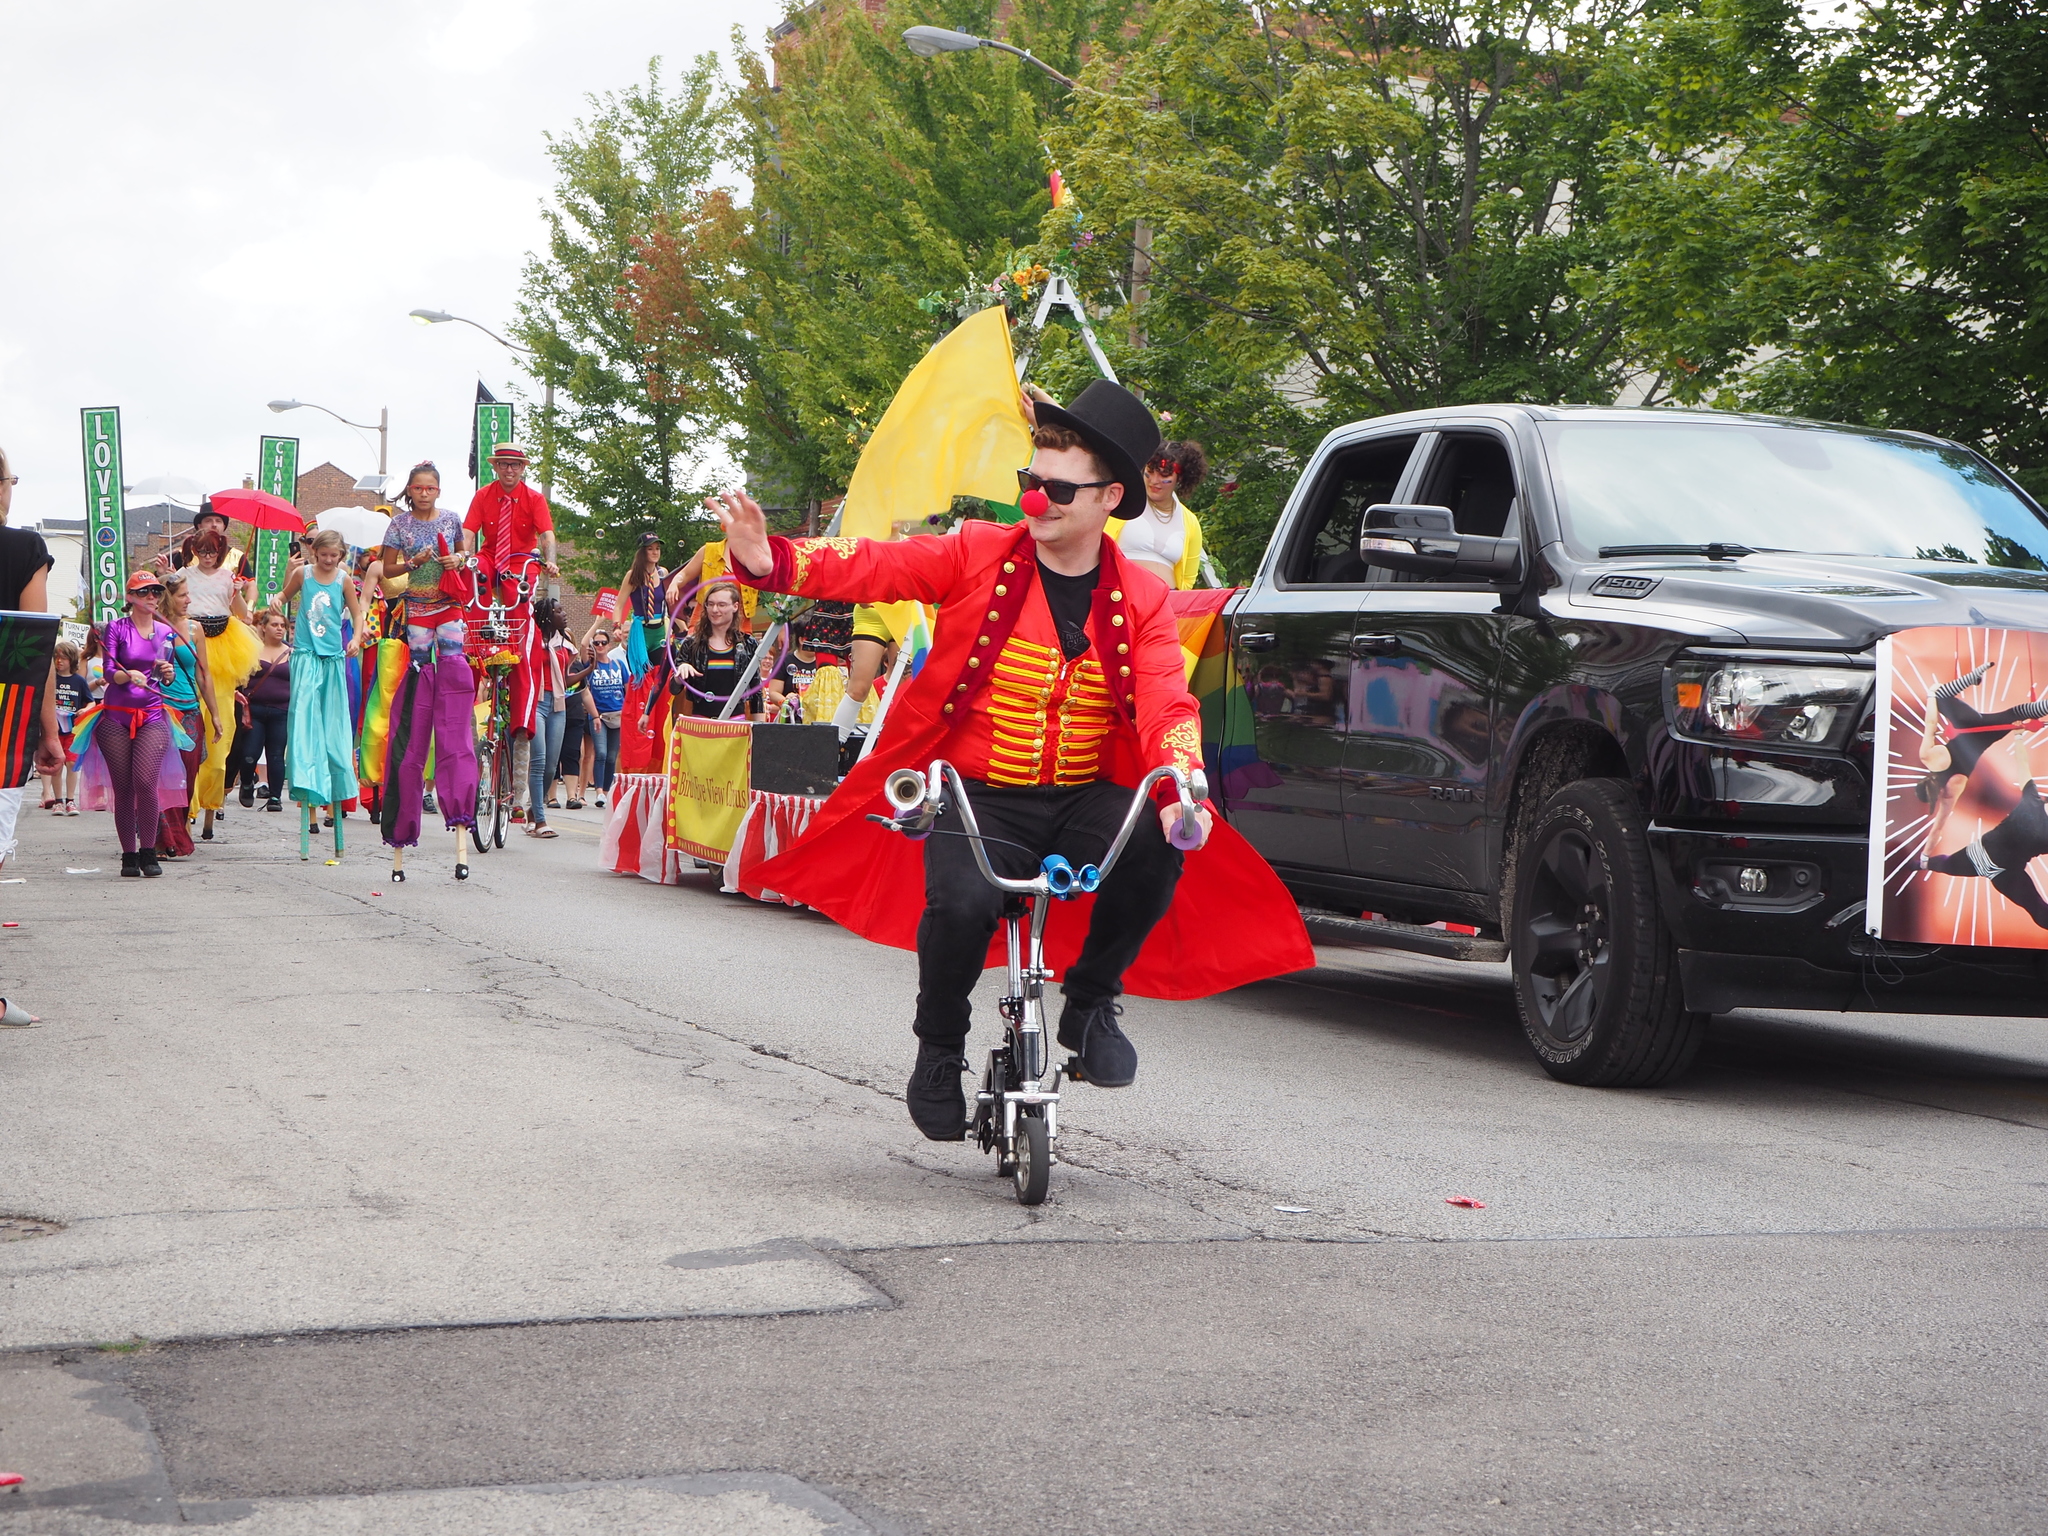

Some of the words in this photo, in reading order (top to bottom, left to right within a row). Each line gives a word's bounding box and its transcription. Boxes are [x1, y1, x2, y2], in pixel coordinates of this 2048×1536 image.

[93, 414, 112, 523] LOVE
[269, 538, 279, 578] THE
[1605, 577, 1651, 590] 1500
[65, 622, 80, 630] TURN
[68, 630, 85, 640] PRIDE
[592, 669, 622, 680] SAM
[706, 777, 725, 806] View
[1429, 785, 1473, 802] RAM
